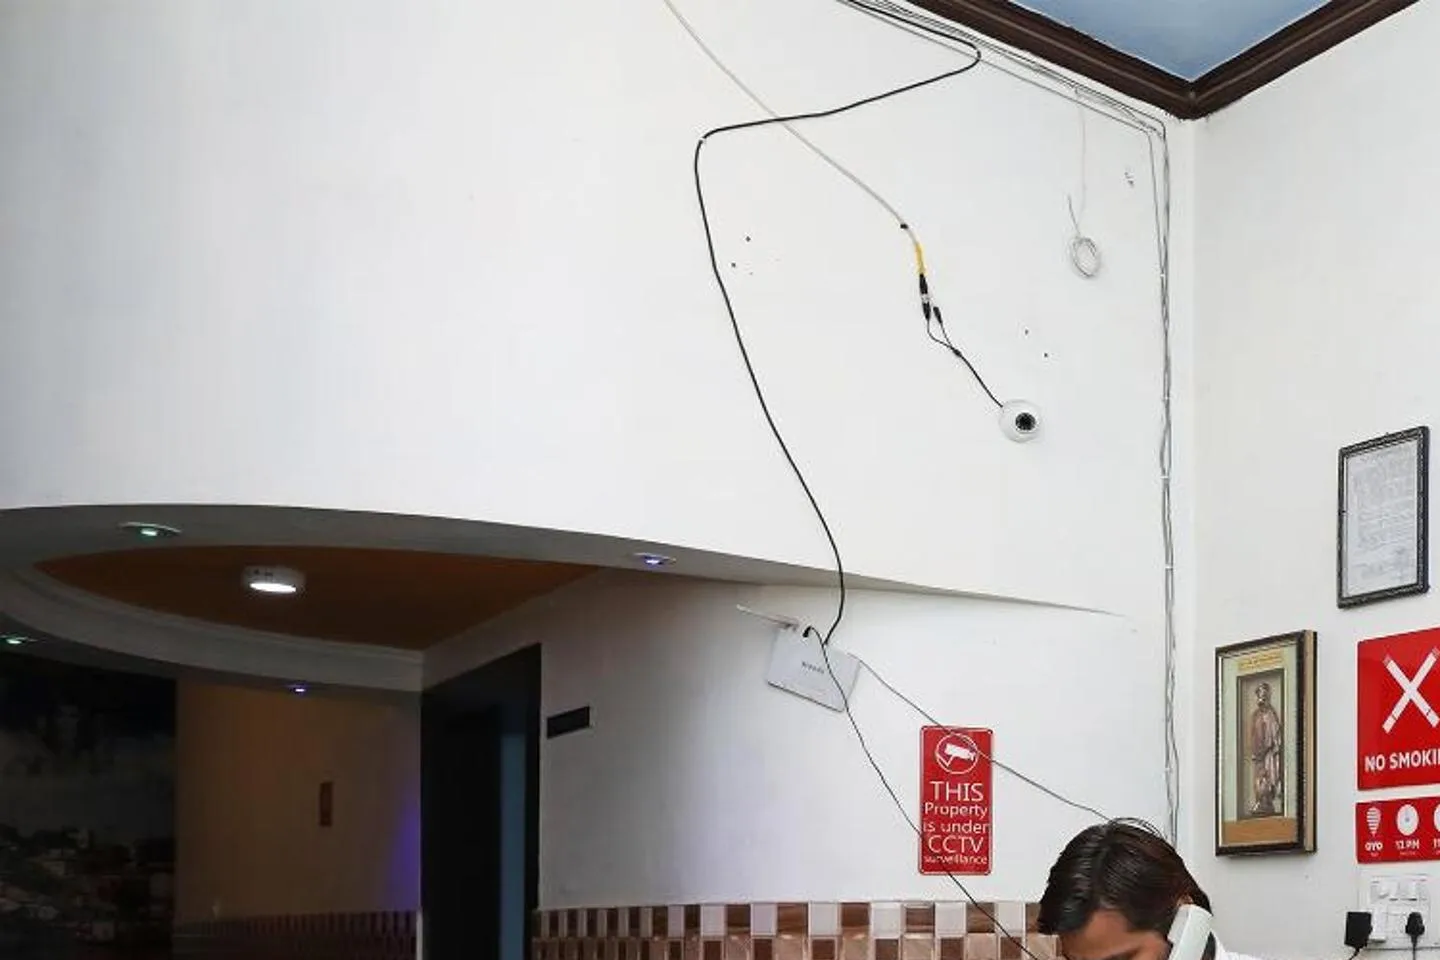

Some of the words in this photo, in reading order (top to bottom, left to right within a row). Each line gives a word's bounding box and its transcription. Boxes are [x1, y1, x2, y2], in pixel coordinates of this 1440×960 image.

[1364, 754, 1386, 773] NO
[929, 780, 983, 801] THIS
[924, 802, 987, 819] Property
[923, 820, 935, 832] is
[941, 820, 989, 834] under
[928, 834, 984, 853] CCTV
